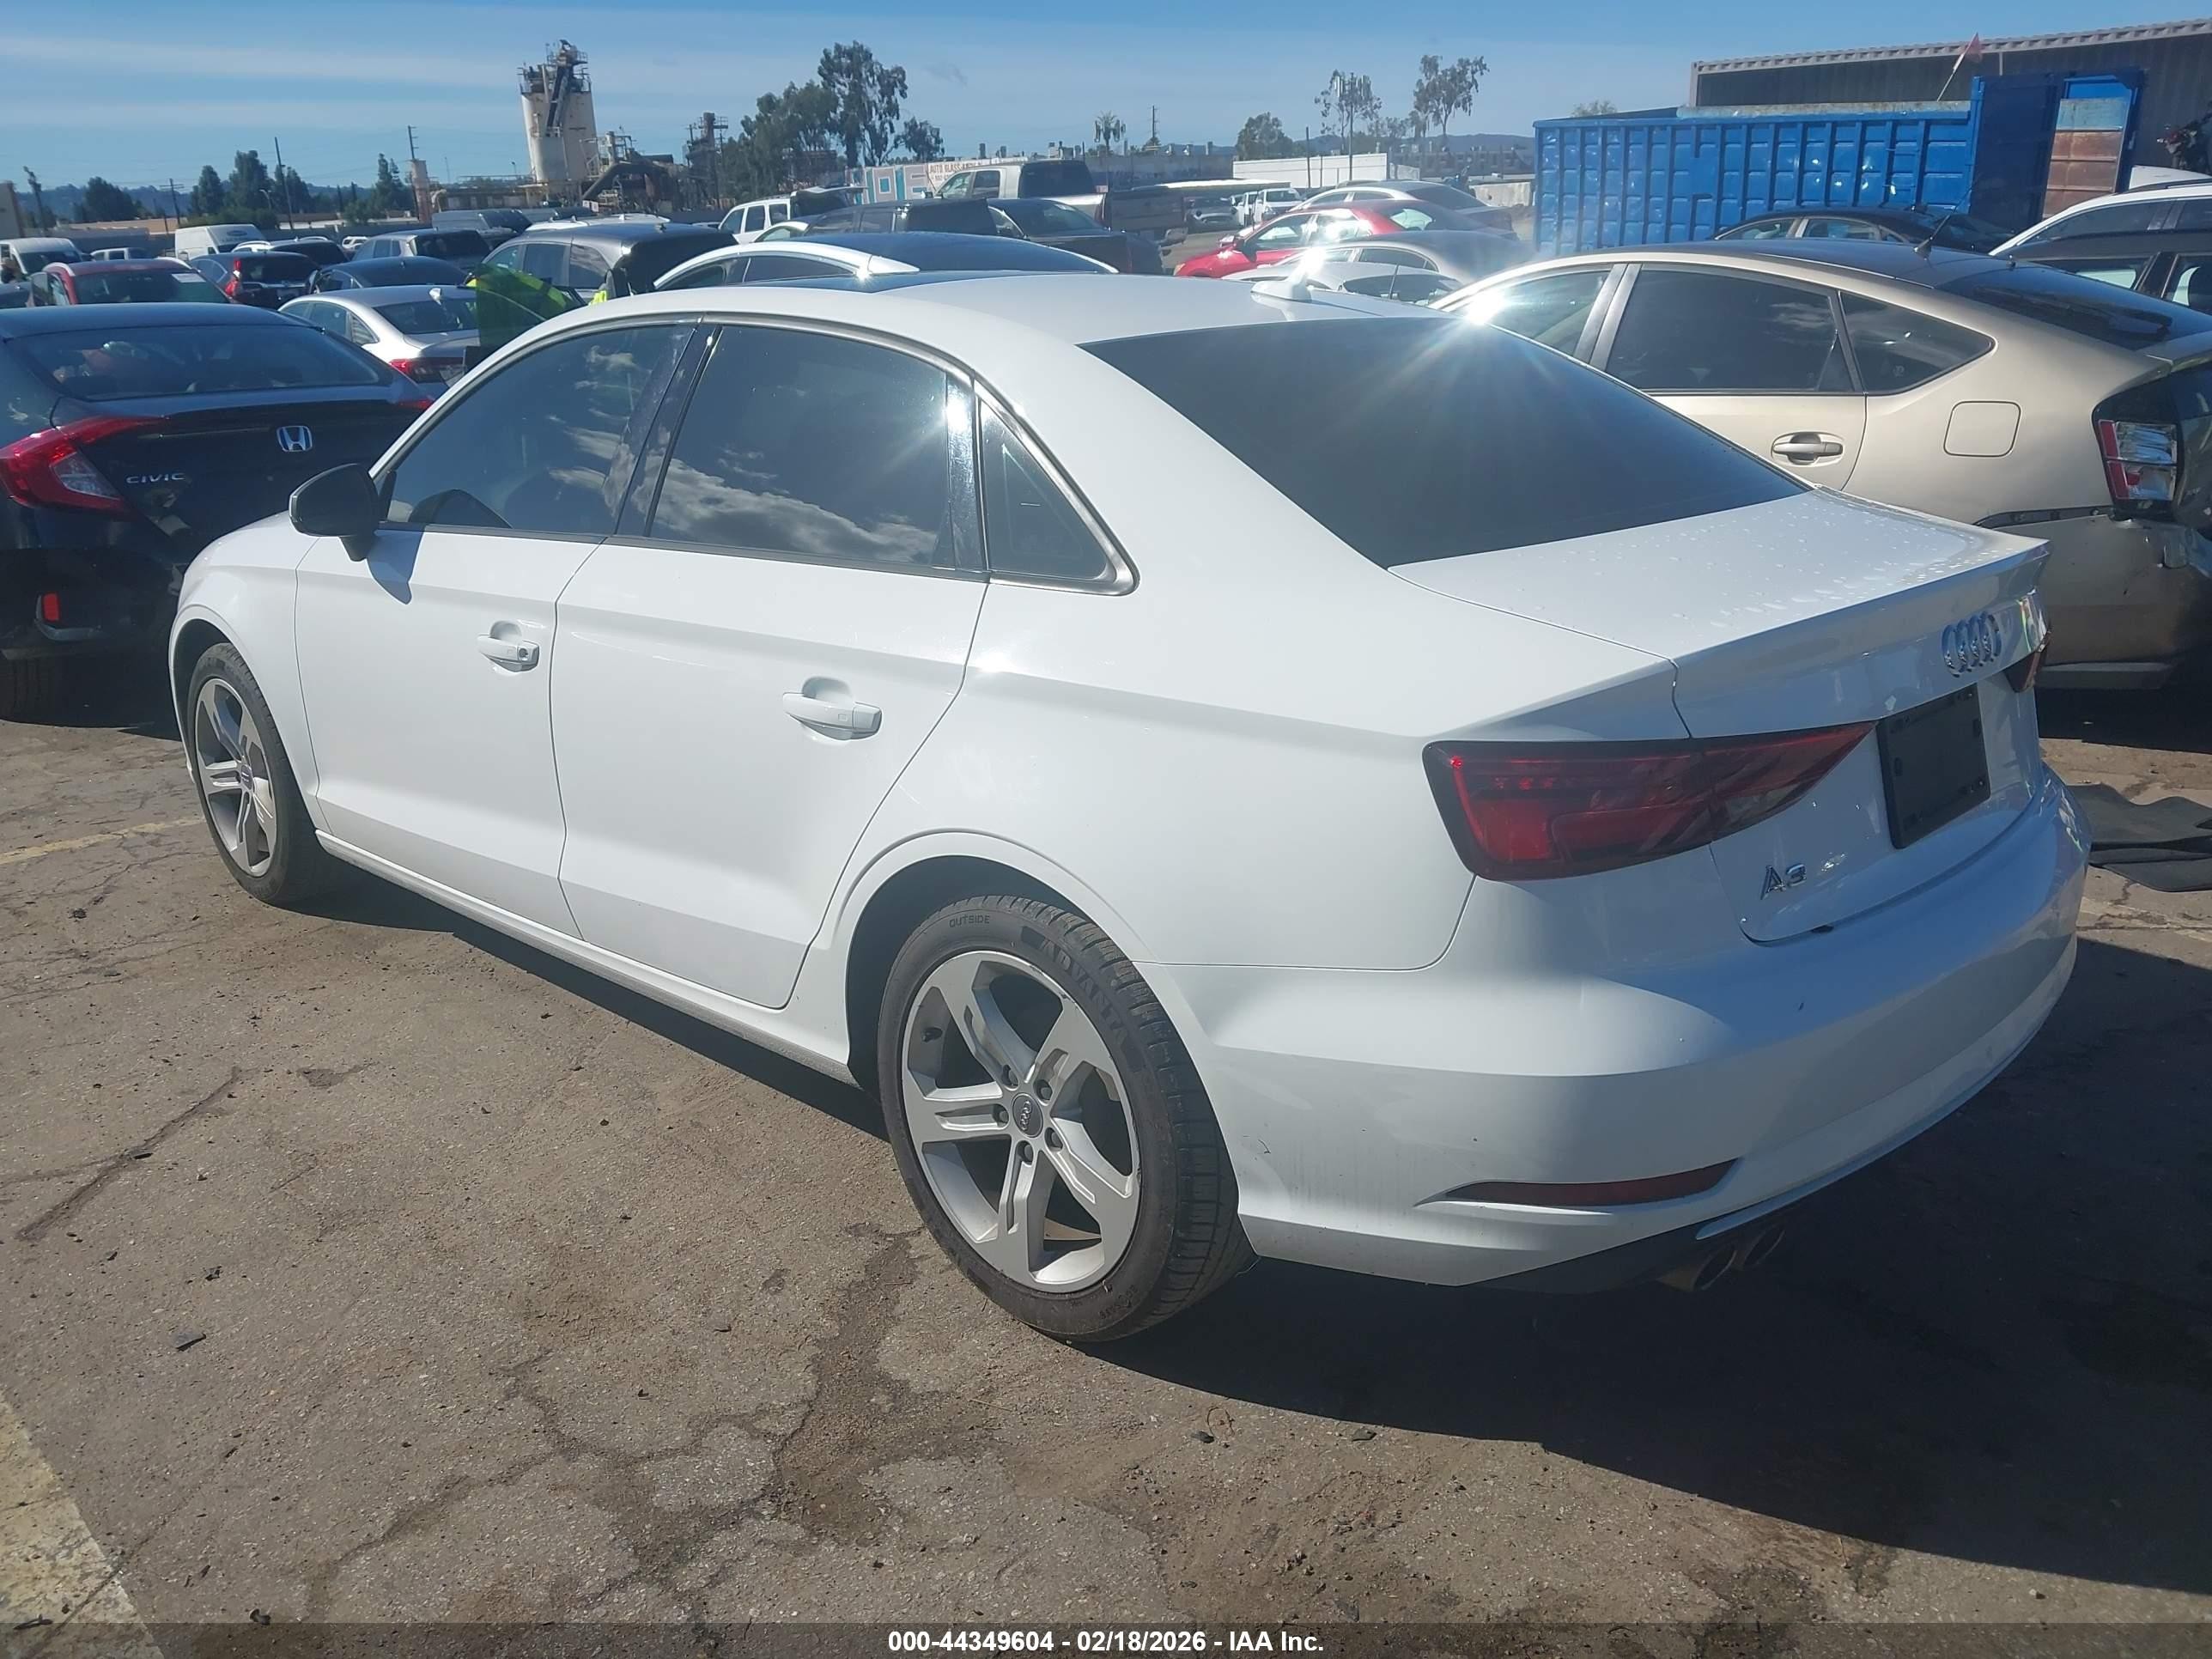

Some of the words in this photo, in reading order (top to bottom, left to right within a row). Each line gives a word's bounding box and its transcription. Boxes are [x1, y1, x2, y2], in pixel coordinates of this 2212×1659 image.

[126, 472, 186, 484] CIVIC
[1759, 863, 1807, 900] A3
[949, 914, 989, 928] OUTSIDE
